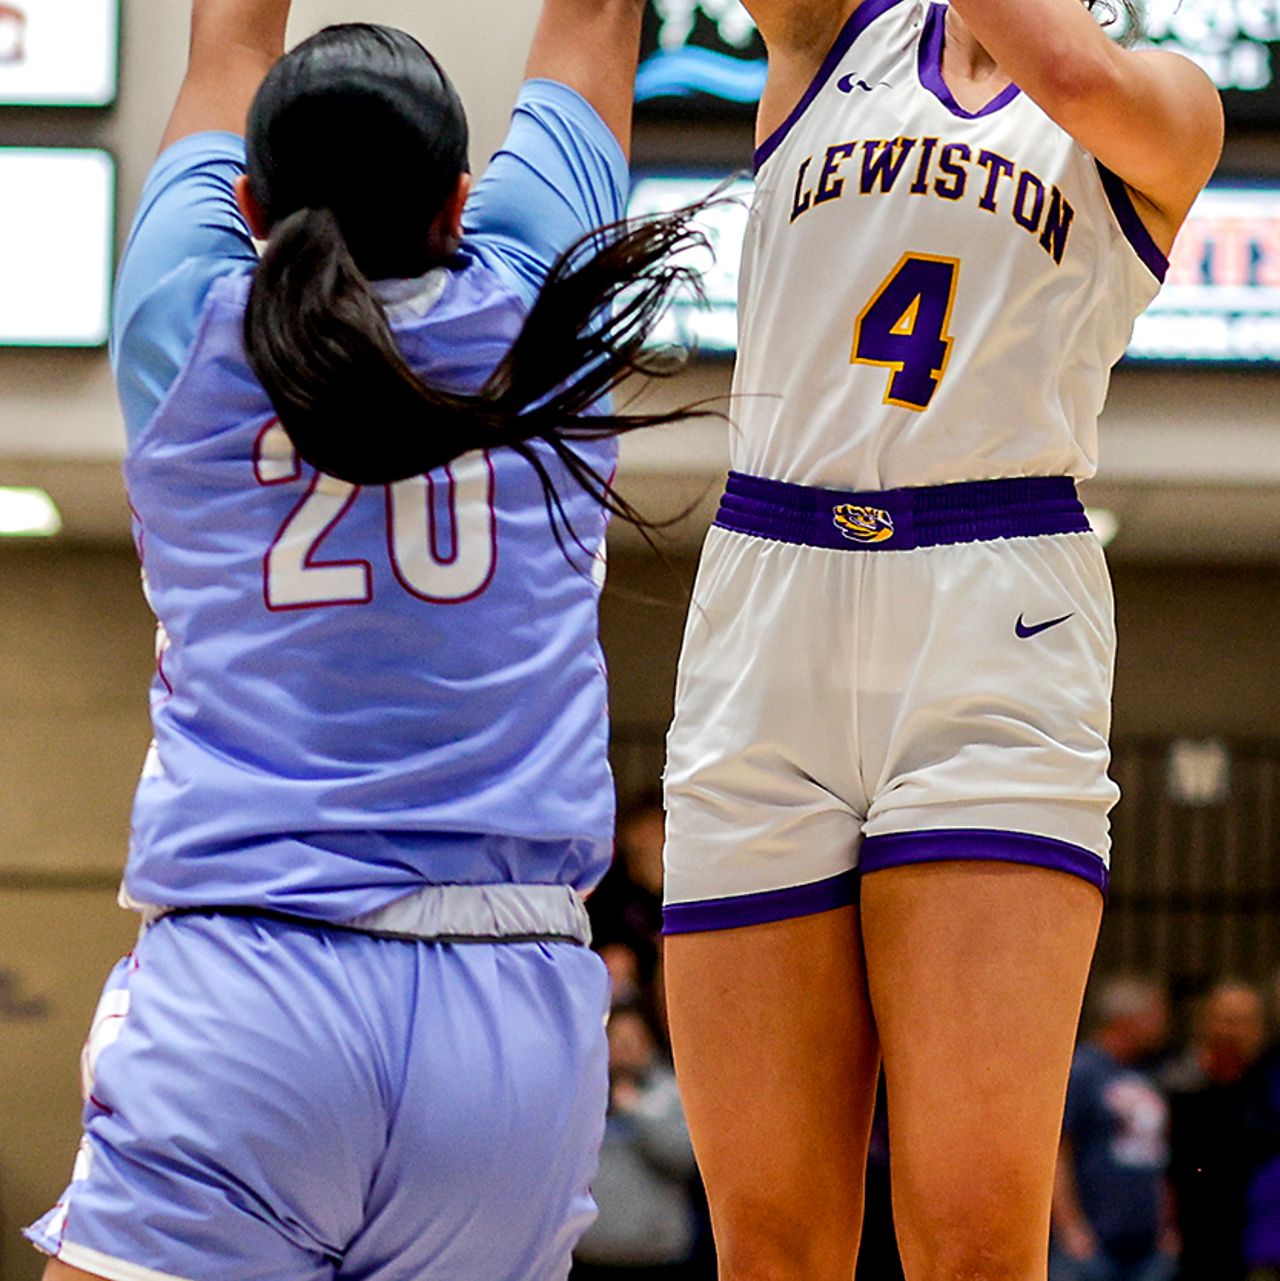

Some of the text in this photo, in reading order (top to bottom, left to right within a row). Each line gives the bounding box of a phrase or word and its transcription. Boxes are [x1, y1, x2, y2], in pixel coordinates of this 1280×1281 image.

[789, 135, 1075, 267] LEWISTON
[849, 250, 961, 412] 4
[253, 415, 498, 613] 20
